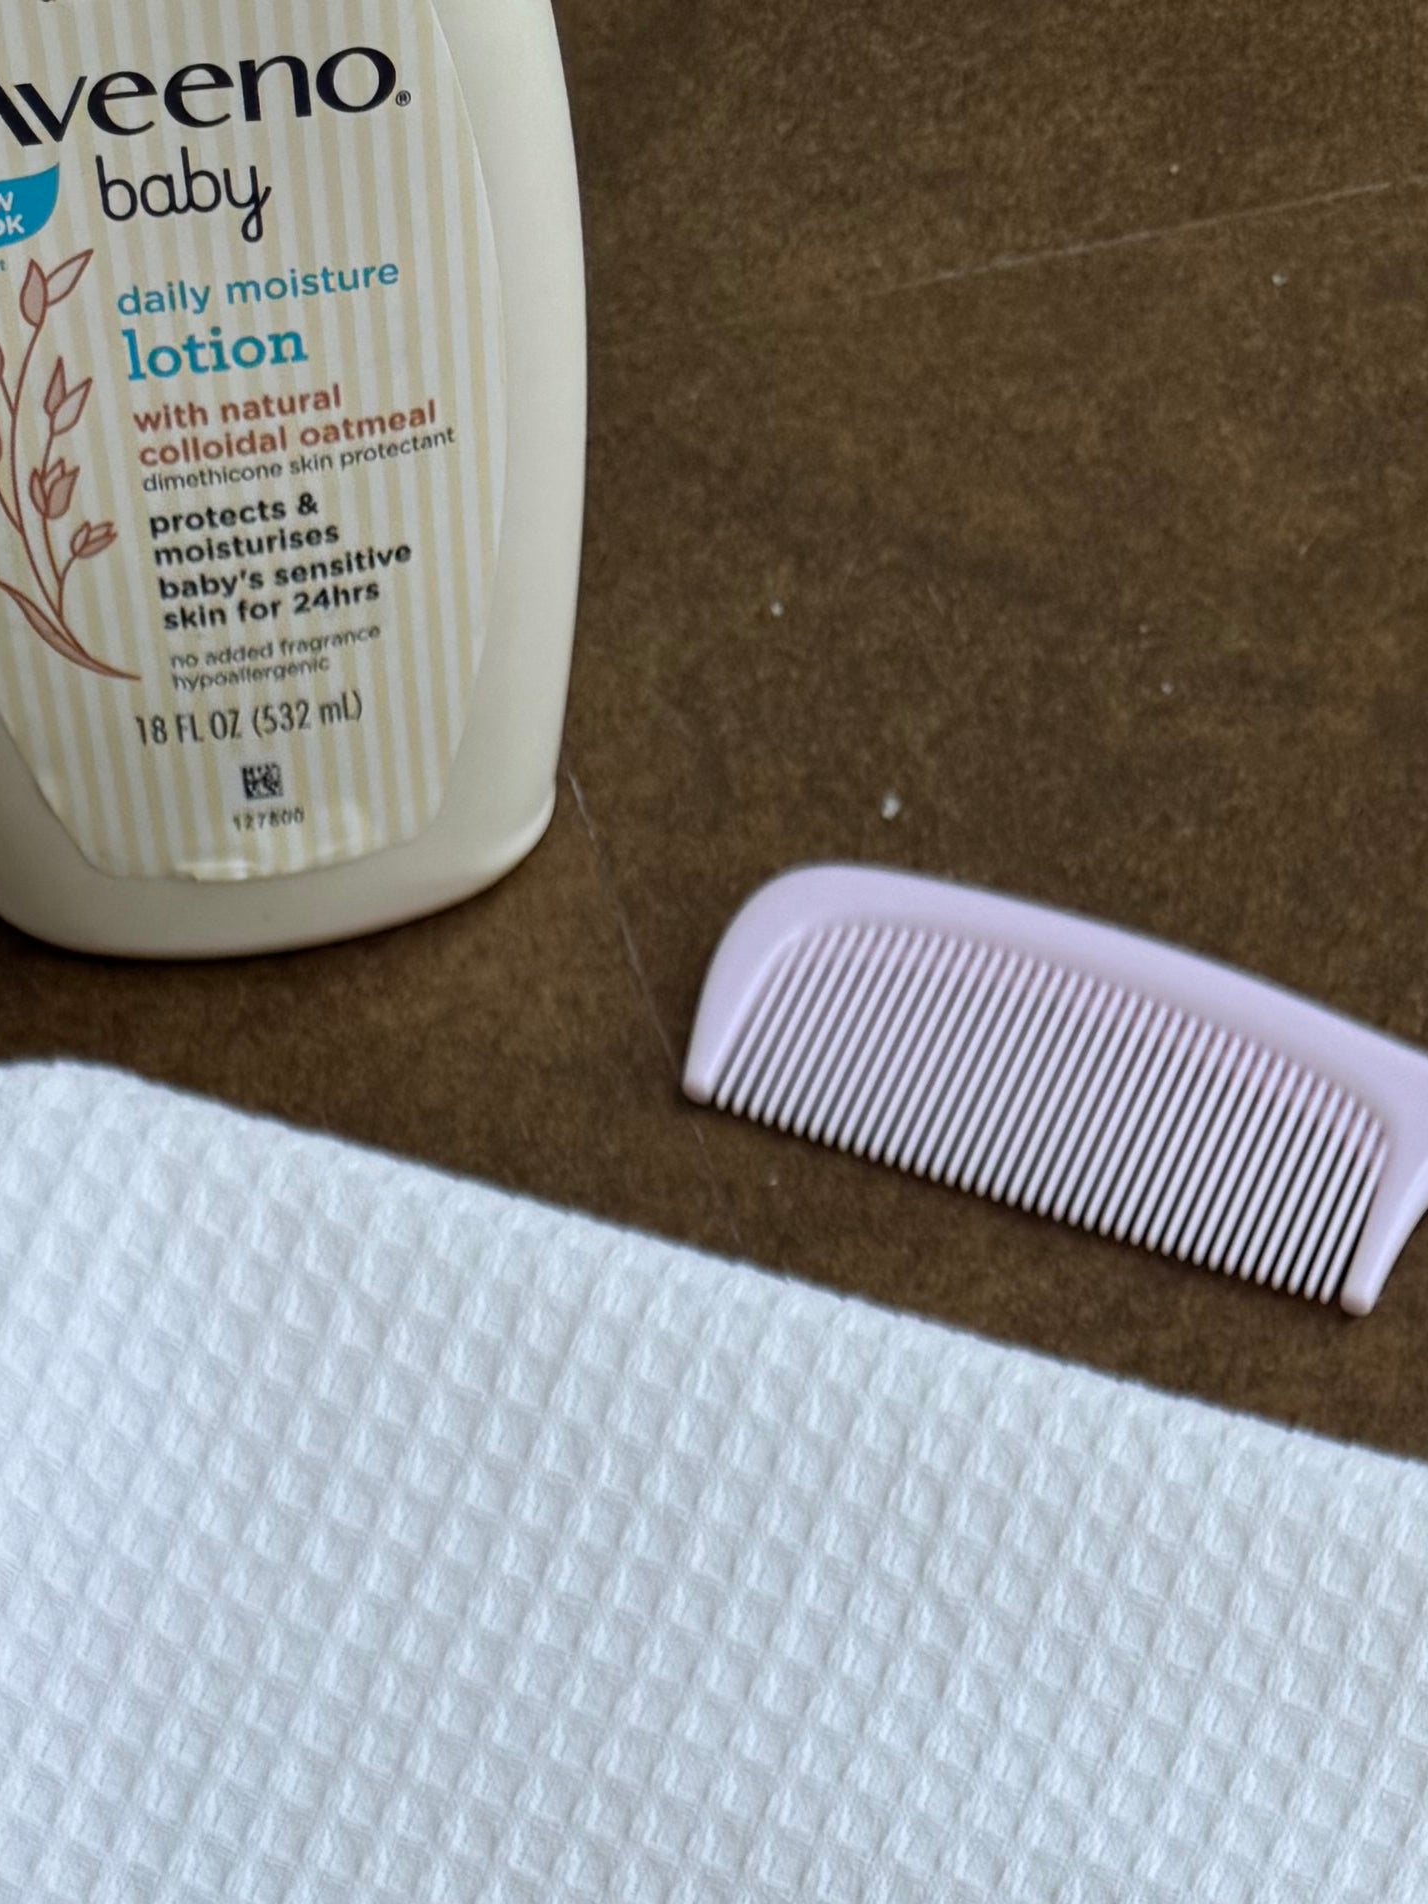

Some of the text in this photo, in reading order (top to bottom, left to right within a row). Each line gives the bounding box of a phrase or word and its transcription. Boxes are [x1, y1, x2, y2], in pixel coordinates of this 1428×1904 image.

[95, 147, 272, 242] baby
[117, 260, 400, 319] daily moisture
[121, 324, 309, 382] lotion
[134, 383, 341, 432] with natural
[139, 399, 437, 468] colloidal oatmeal
[143, 427, 456, 493] dimethicone skin protectant
[150, 491, 319, 540] protects &
[154, 525, 339, 567] moisturises
[159, 544, 412, 603] baby's sensitive
[164, 581, 381, 630] skin for 24hrs
[171, 624, 382, 669] no added fragrance
[172, 655, 330, 692] hypoallergenic
[135, 690, 363, 746] 18 FL OZ (532 mL)
